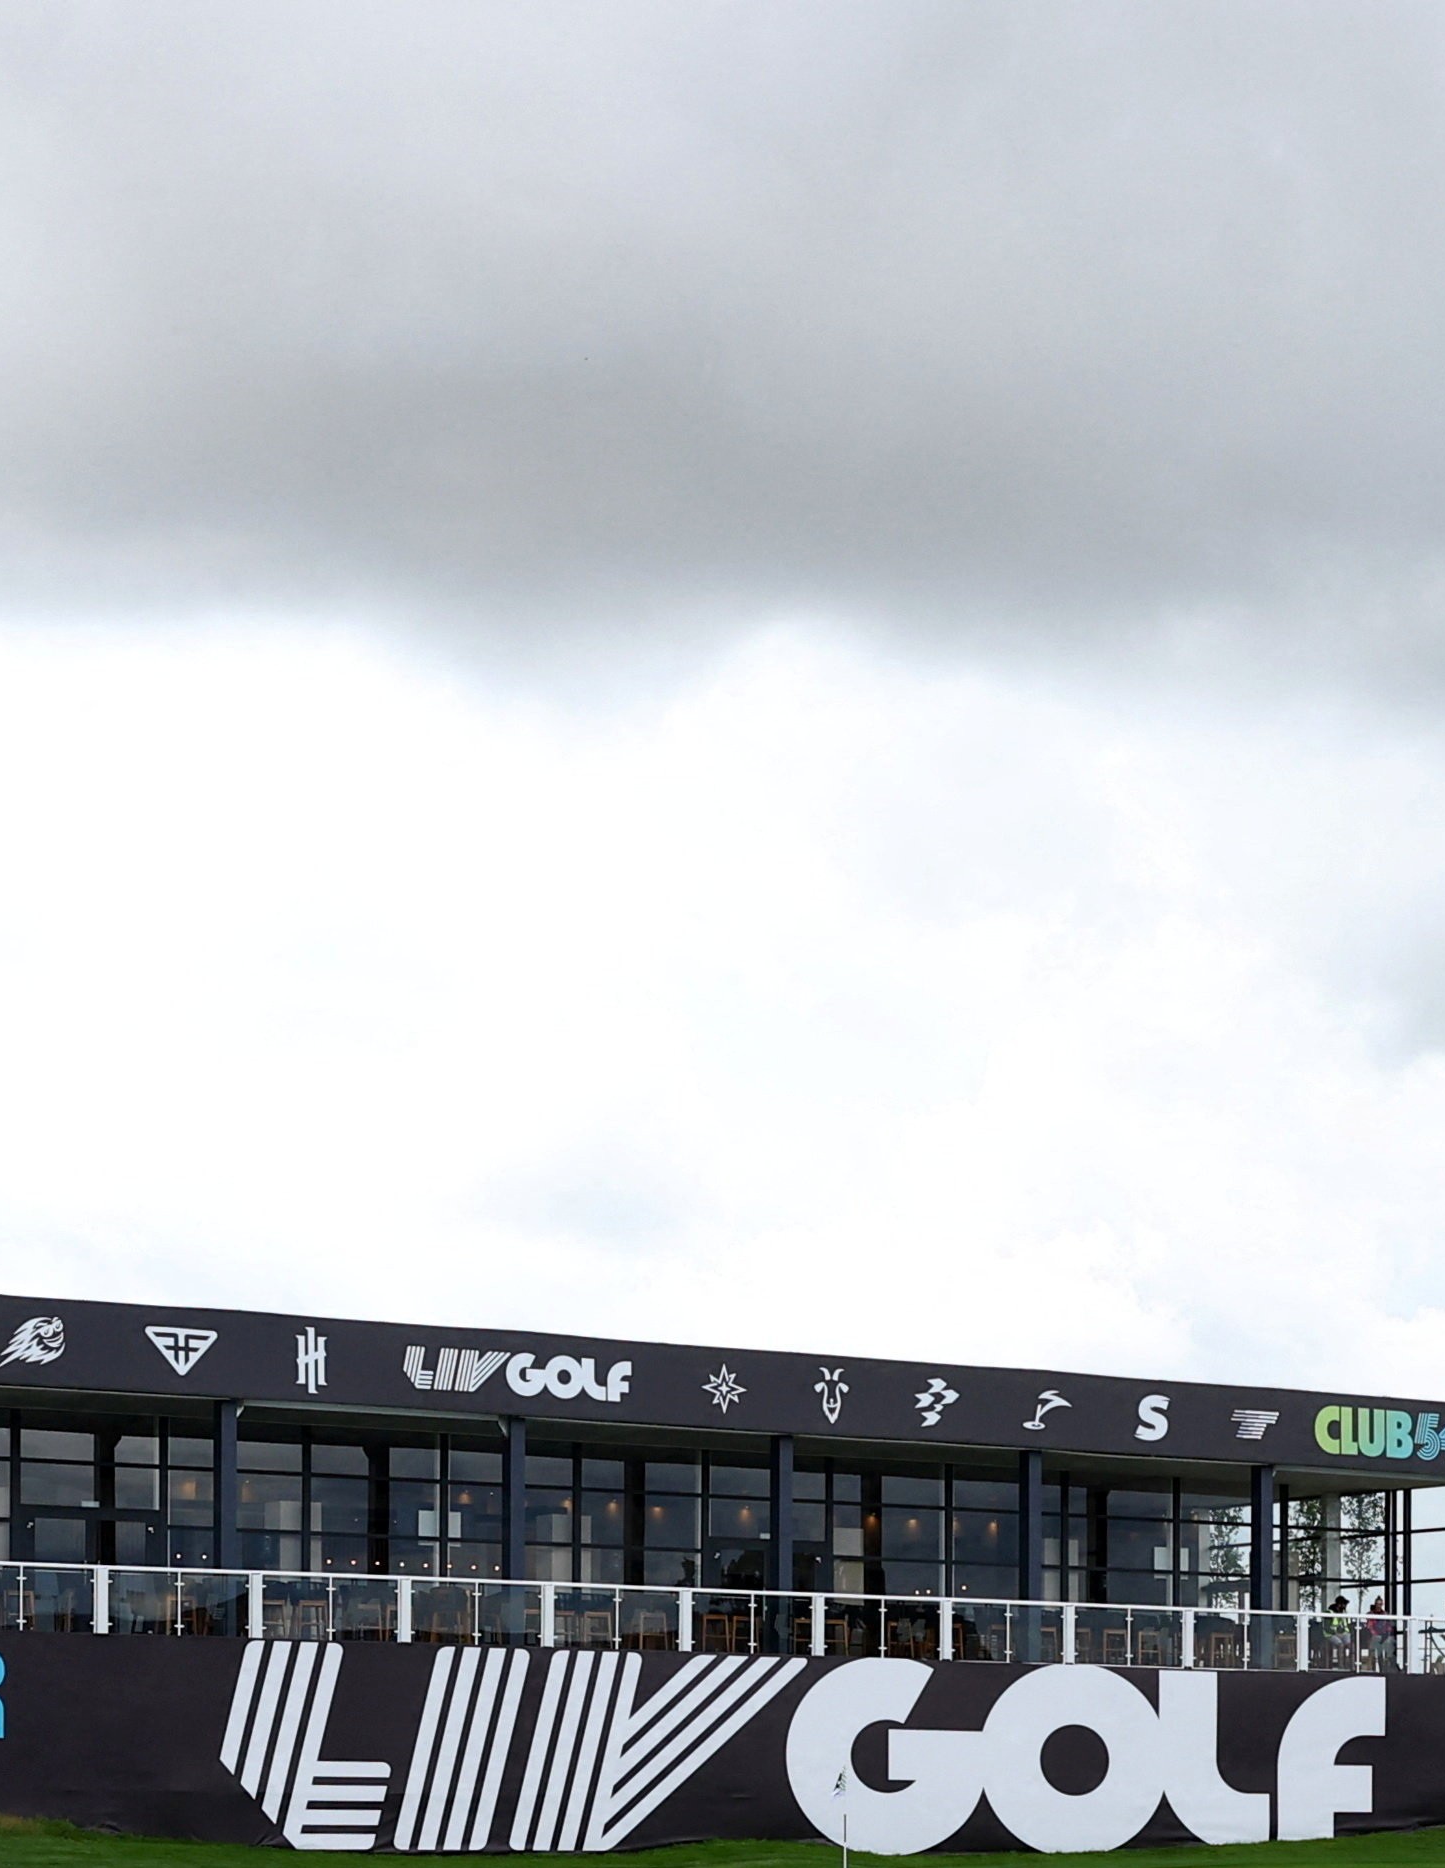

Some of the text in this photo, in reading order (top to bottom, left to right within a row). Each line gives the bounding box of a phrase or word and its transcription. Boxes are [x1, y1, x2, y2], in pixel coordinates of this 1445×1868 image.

[403, 1345, 632, 1402] LIV GOLF
[1314, 1405, 1414, 1459] CLUB
[219, 1641, 1387, 1855] LIV GOLF
